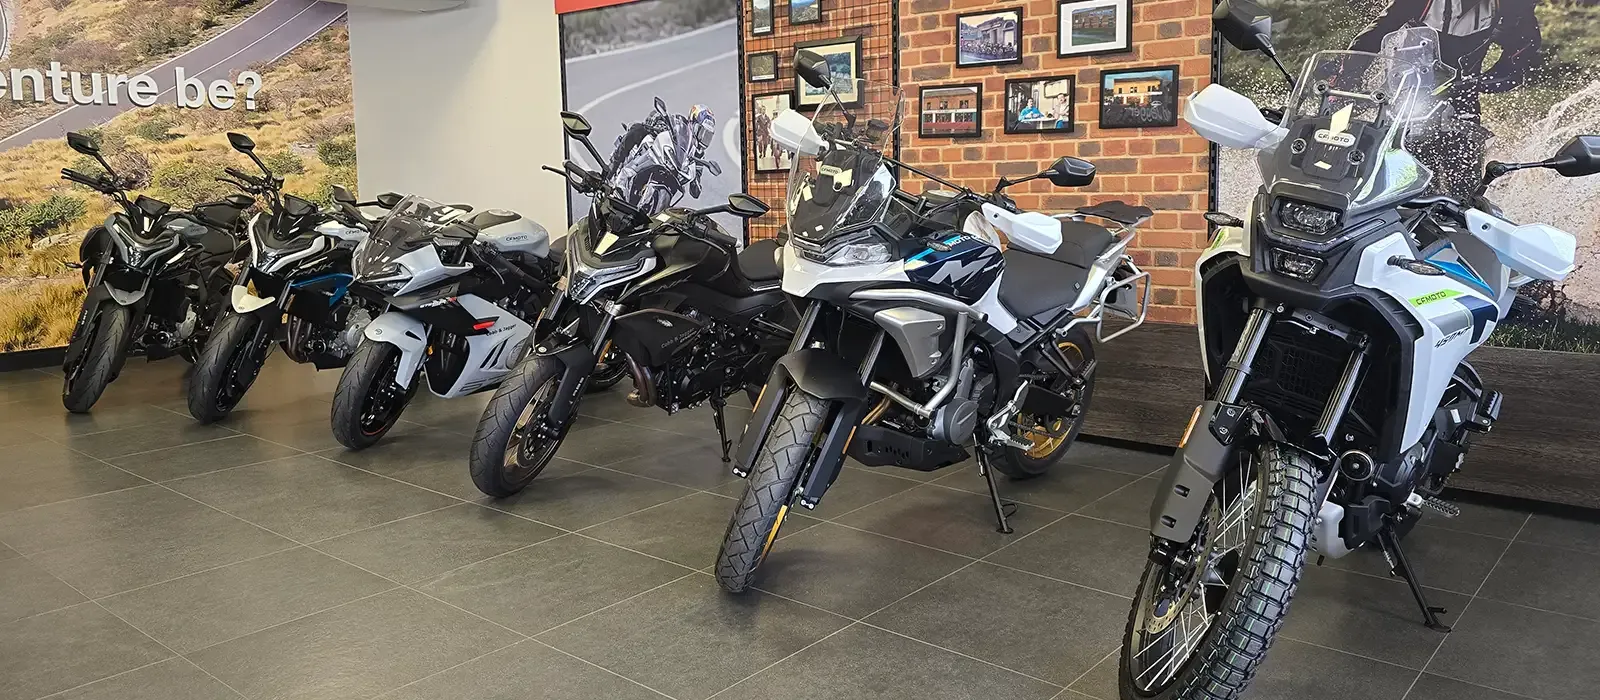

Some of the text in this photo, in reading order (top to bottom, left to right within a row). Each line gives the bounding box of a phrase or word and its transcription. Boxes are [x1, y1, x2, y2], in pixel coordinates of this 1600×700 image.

[0, 61, 262, 110] nture be?
[1415, 290, 1447, 306] CFMOTO
